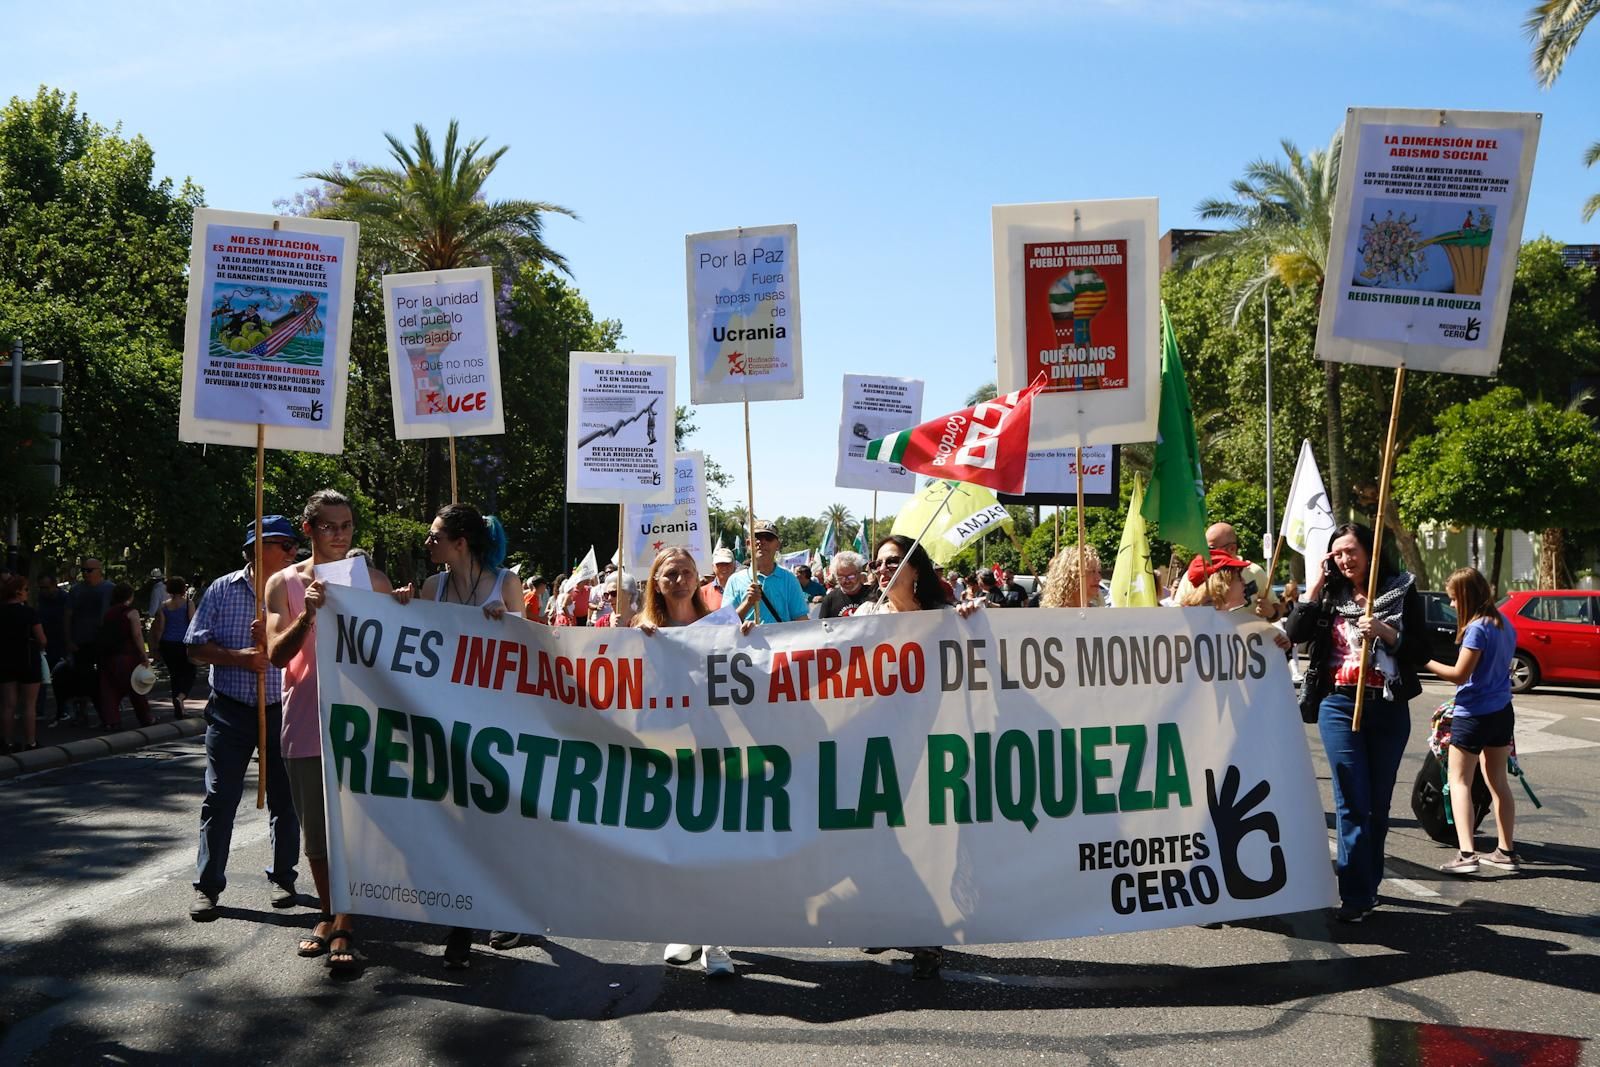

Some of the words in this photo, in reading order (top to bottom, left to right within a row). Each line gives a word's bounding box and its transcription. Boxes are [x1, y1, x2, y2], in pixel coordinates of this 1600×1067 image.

[1385, 136, 1399, 144] LA
[1402, 136, 1473, 148] DIMENSIÓN
[1476, 140, 1498, 149] DEL
[1390, 148, 1440, 159] ABISMO
[1443, 150, 1488, 161] SOCIAL
[1391, 172, 1425, 180] ESPAÑOLES
[1464, 177, 1509, 185] AUMENTARON
[1448, 183, 1479, 191] MILLONES
[231, 236, 244, 244] NO
[248, 237, 260, 245] ES
[227, 246, 265, 256] ATRACO
[267, 250, 337, 262] MONOPOLISTA
[1034, 247, 1052, 257] POR
[1054, 246, 1065, 256] LA
[1067, 245, 1101, 255] UNIDAD
[1103, 244, 1118, 254] DEL
[700, 253, 728, 269] Por
[734, 251, 746, 266] la
[753, 248, 784, 264] Paz
[1030, 258, 1063, 268] PUEBLO
[1065, 255, 1122, 266] TRABAJADOR
[227, 265, 265, 273] INFLACIÓN
[289, 270, 326, 279] BANQUETE
[752, 273, 784, 285] Fuera
[227, 273, 269, 282] GANANCIAS
[270, 276, 327, 288] MONOPOLISTAS
[397, 297, 419, 309] Por
[422, 296, 432, 307] la
[436, 292, 478, 306] unidad
[716, 293, 751, 307] tropas
[754, 290, 784, 301] rusas
[1348, 292, 1420, 305] REDISTRIBUIR
[1422, 297, 1434, 307] LA
[1437, 298, 1481, 310] RIQUEZA
[771, 306, 786, 317] de
[398, 315, 417, 327] del
[421, 312, 463, 328] pueblo
[400, 331, 462, 346] trabajador
[713, 324, 786, 342] Ucrania
[1444, 330, 1464, 338] CERO
[1039, 348, 1067, 364] QUE
[1068, 347, 1087, 363] NO
[1089, 345, 1116, 361] NOS
[236, 363, 282, 373] REDISTRIBUIR
[293, 368, 319, 376] RIQUEZA
[420, 360, 443, 371] Que
[446, 359, 461, 368] no
[463, 357, 484, 367] nos
[1051, 362, 1105, 379] DIVIDAN
[222, 370, 233, 378] QUE
[235, 371, 260, 380] BANCOS
[267, 374, 310, 384] MONOPOLIOS
[446, 373, 485, 385] dividan
[205, 378, 239, 387] DEVUELVAN
[293, 386, 320, 394] ROBADO
[447, 392, 486, 413] UCE
[292, 411, 310, 419] CERO
[932, 415, 966, 466] Córdoba
[1082, 465, 1105, 474] UCE
[675, 485, 694, 493] uera
[641, 521, 697, 535] Ucrania
[336, 615, 383, 666] NO
[391, 628, 444, 678] ES
[707, 652, 755, 706] ES
[767, 642, 926, 703] ATRACO
[939, 639, 987, 692] DE
[999, 636, 1067, 690] LOS
[1077, 631, 1267, 687] MONOPOLIOS
[328, 703, 792, 832] REDISTRIBUIR
[818, 736, 906, 831] LA
[927, 722, 1193, 832] RIQUEZA
[1078, 831, 1210, 873] RECORTES
[1111, 864, 1220, 916] CERO
